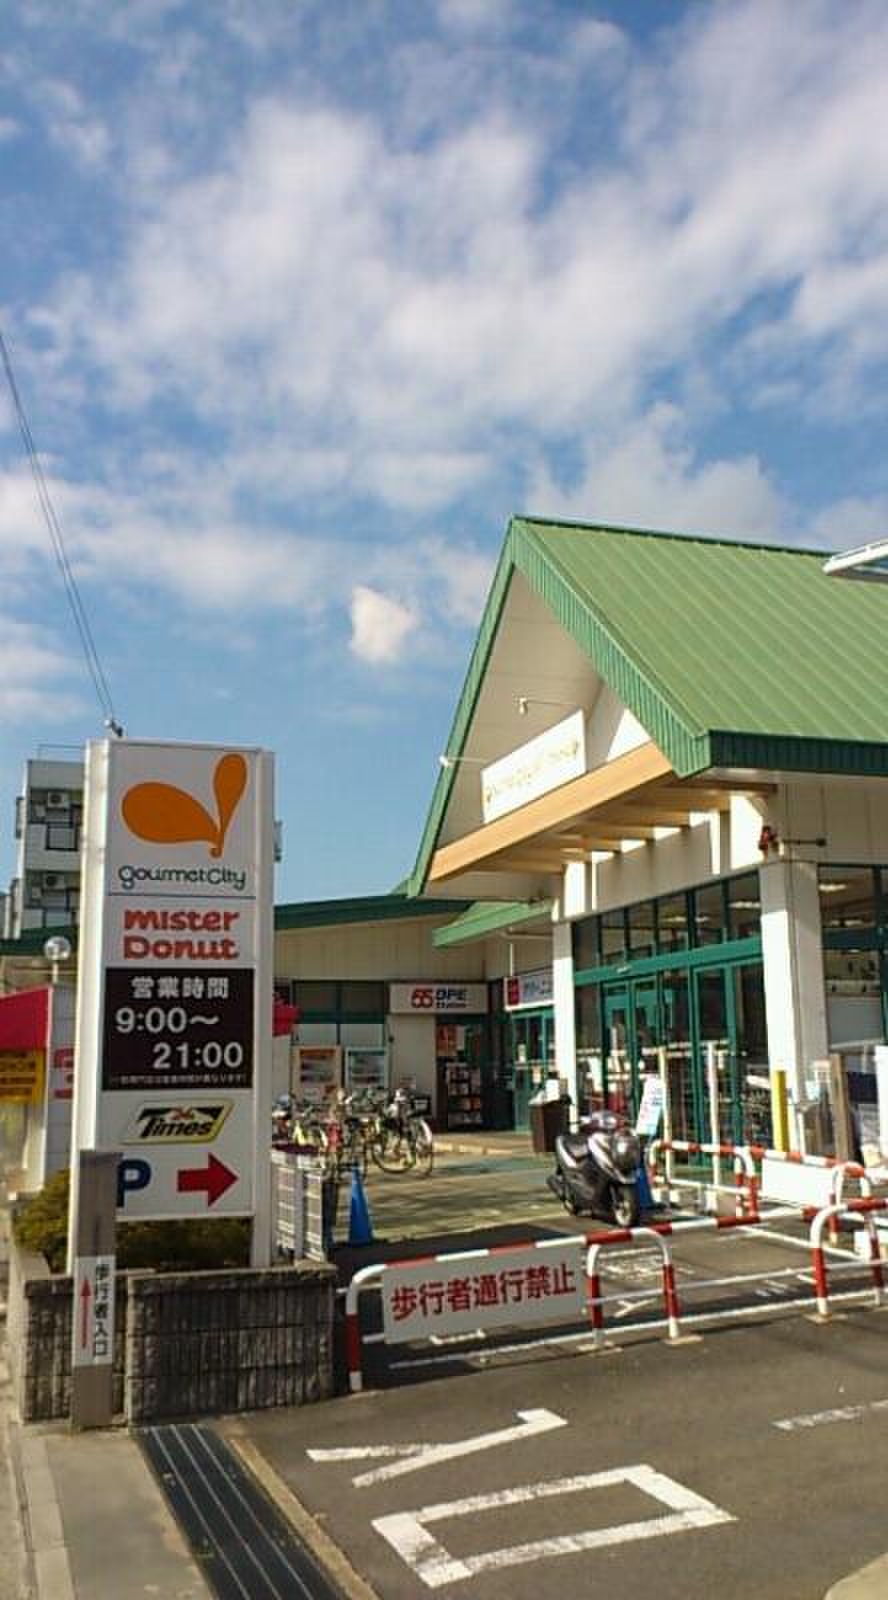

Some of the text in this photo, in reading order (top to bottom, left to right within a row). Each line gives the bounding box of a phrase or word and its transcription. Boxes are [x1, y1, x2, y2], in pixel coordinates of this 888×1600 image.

[123, 936, 239, 960] Donut
[131, 976, 229, 999] 営業時間
[152, 1041, 243, 1069] 21:00
[138, 1107, 216, 1138] Times
[116, 1159, 152, 1208] P
[391, 1263, 577, 1321] 歩行者通行禁止
